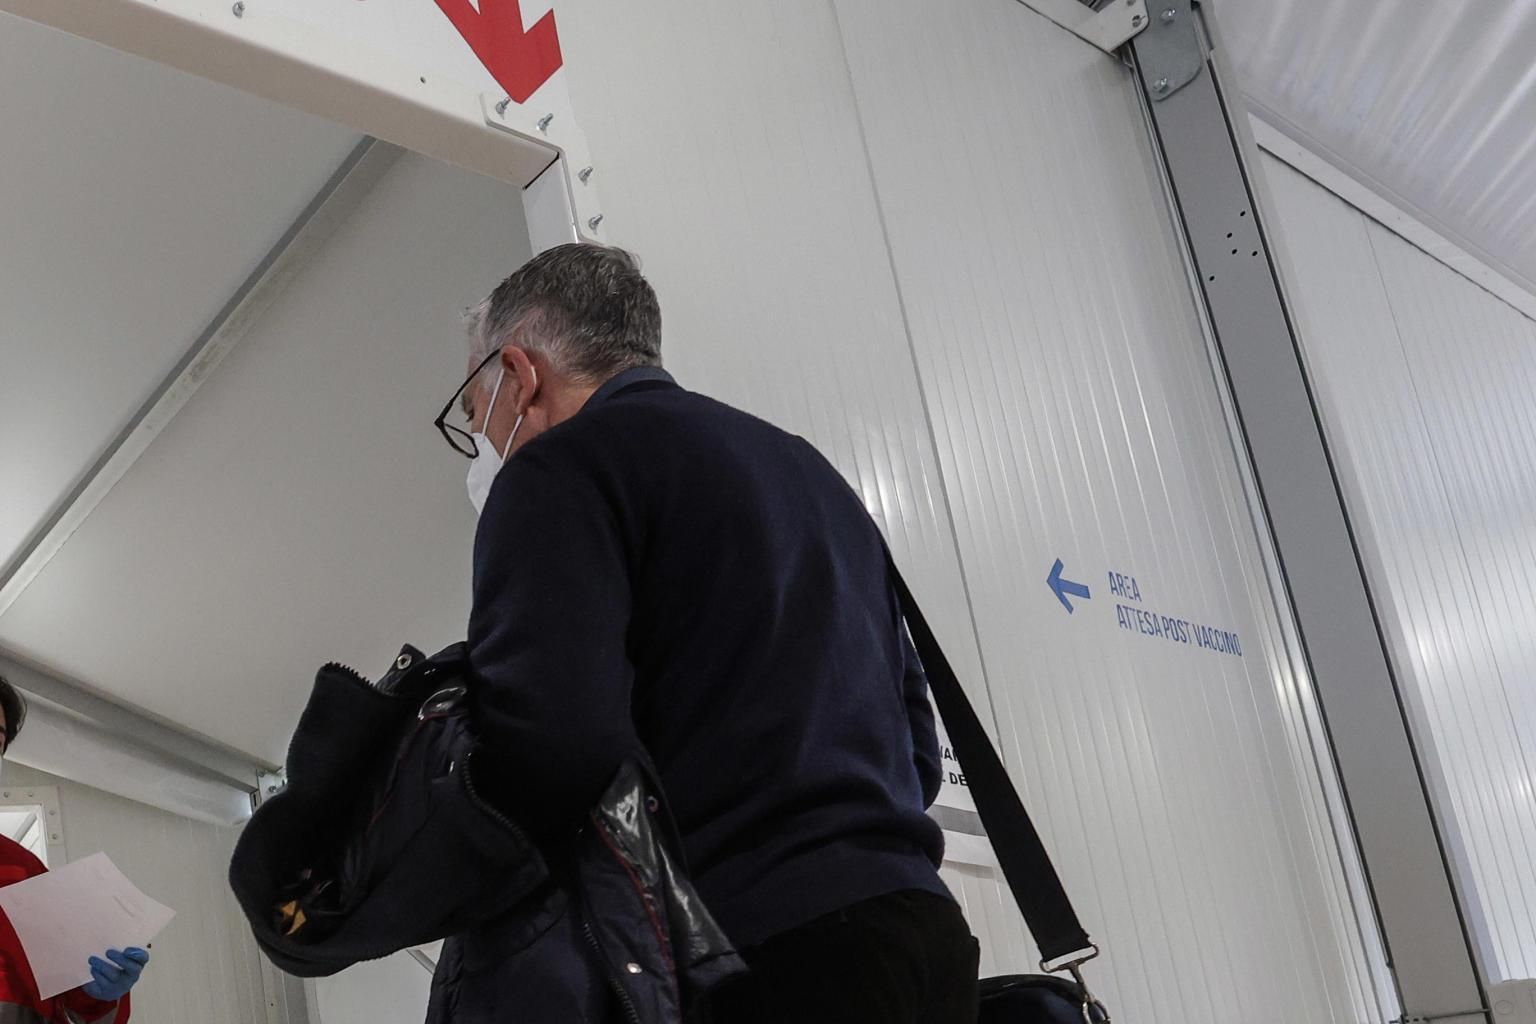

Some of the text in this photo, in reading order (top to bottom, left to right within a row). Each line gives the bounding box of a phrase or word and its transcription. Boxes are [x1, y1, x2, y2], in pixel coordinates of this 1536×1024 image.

[1108, 570, 1143, 602] AREA
[1116, 603, 1243, 657] ATTESA POST VACCINO
